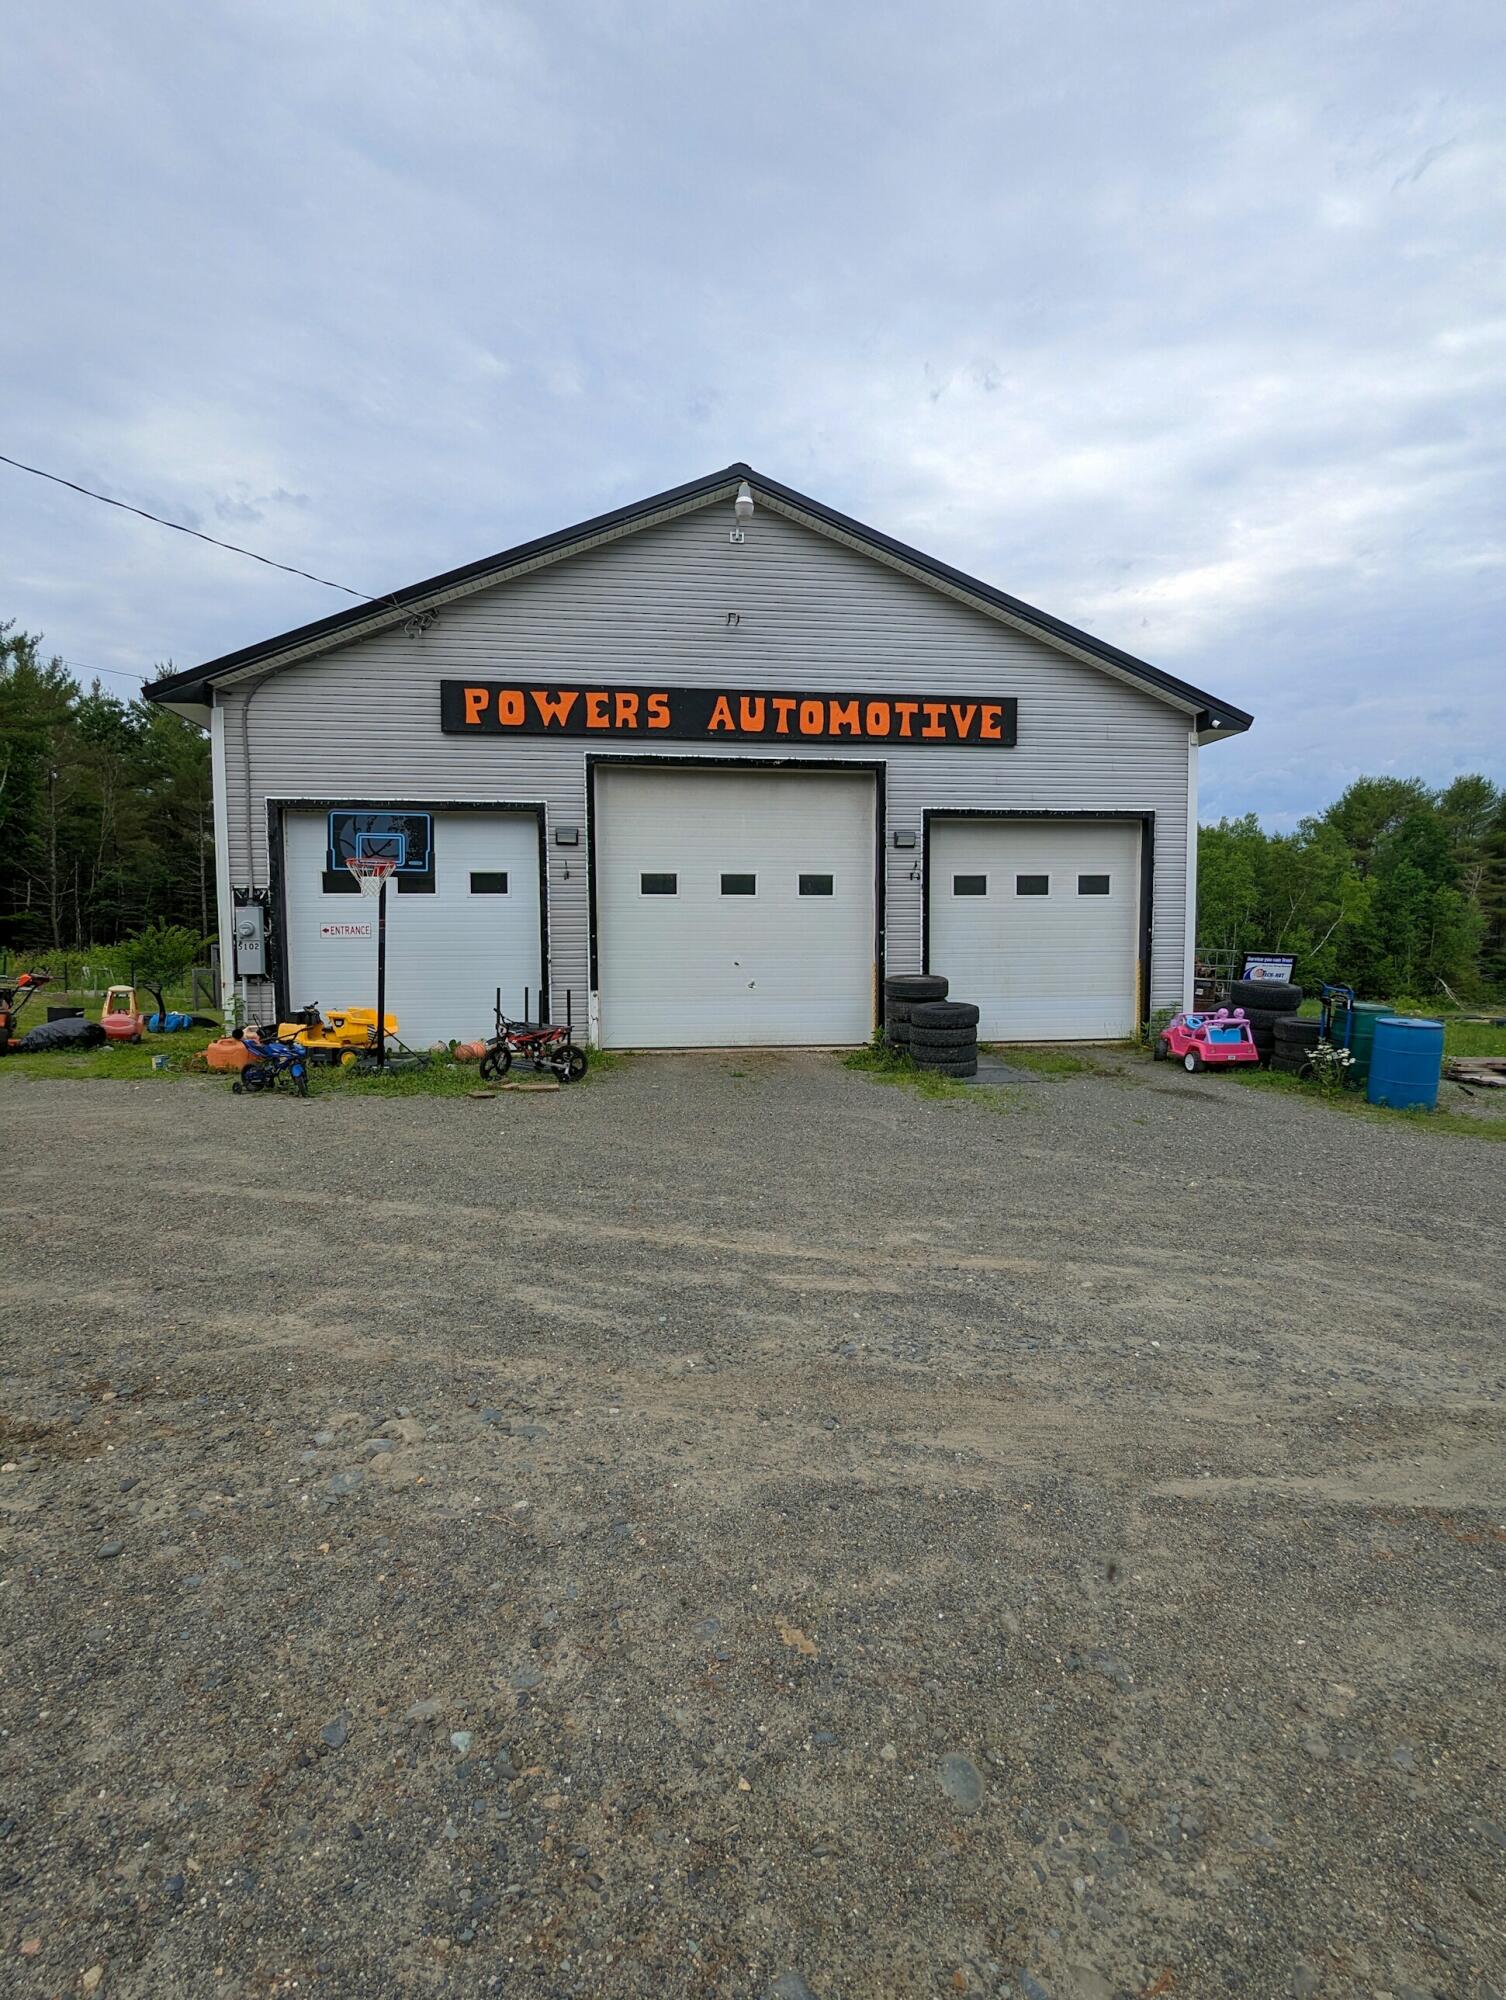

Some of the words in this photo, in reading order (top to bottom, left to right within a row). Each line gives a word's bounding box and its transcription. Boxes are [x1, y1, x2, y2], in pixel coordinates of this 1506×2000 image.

[464, 687, 671, 729] POWERS
[707, 695, 1002, 739] AUTOMOTIVE
[330, 925, 370, 935] ENTRANCE
[238, 943, 260, 951] 5102
